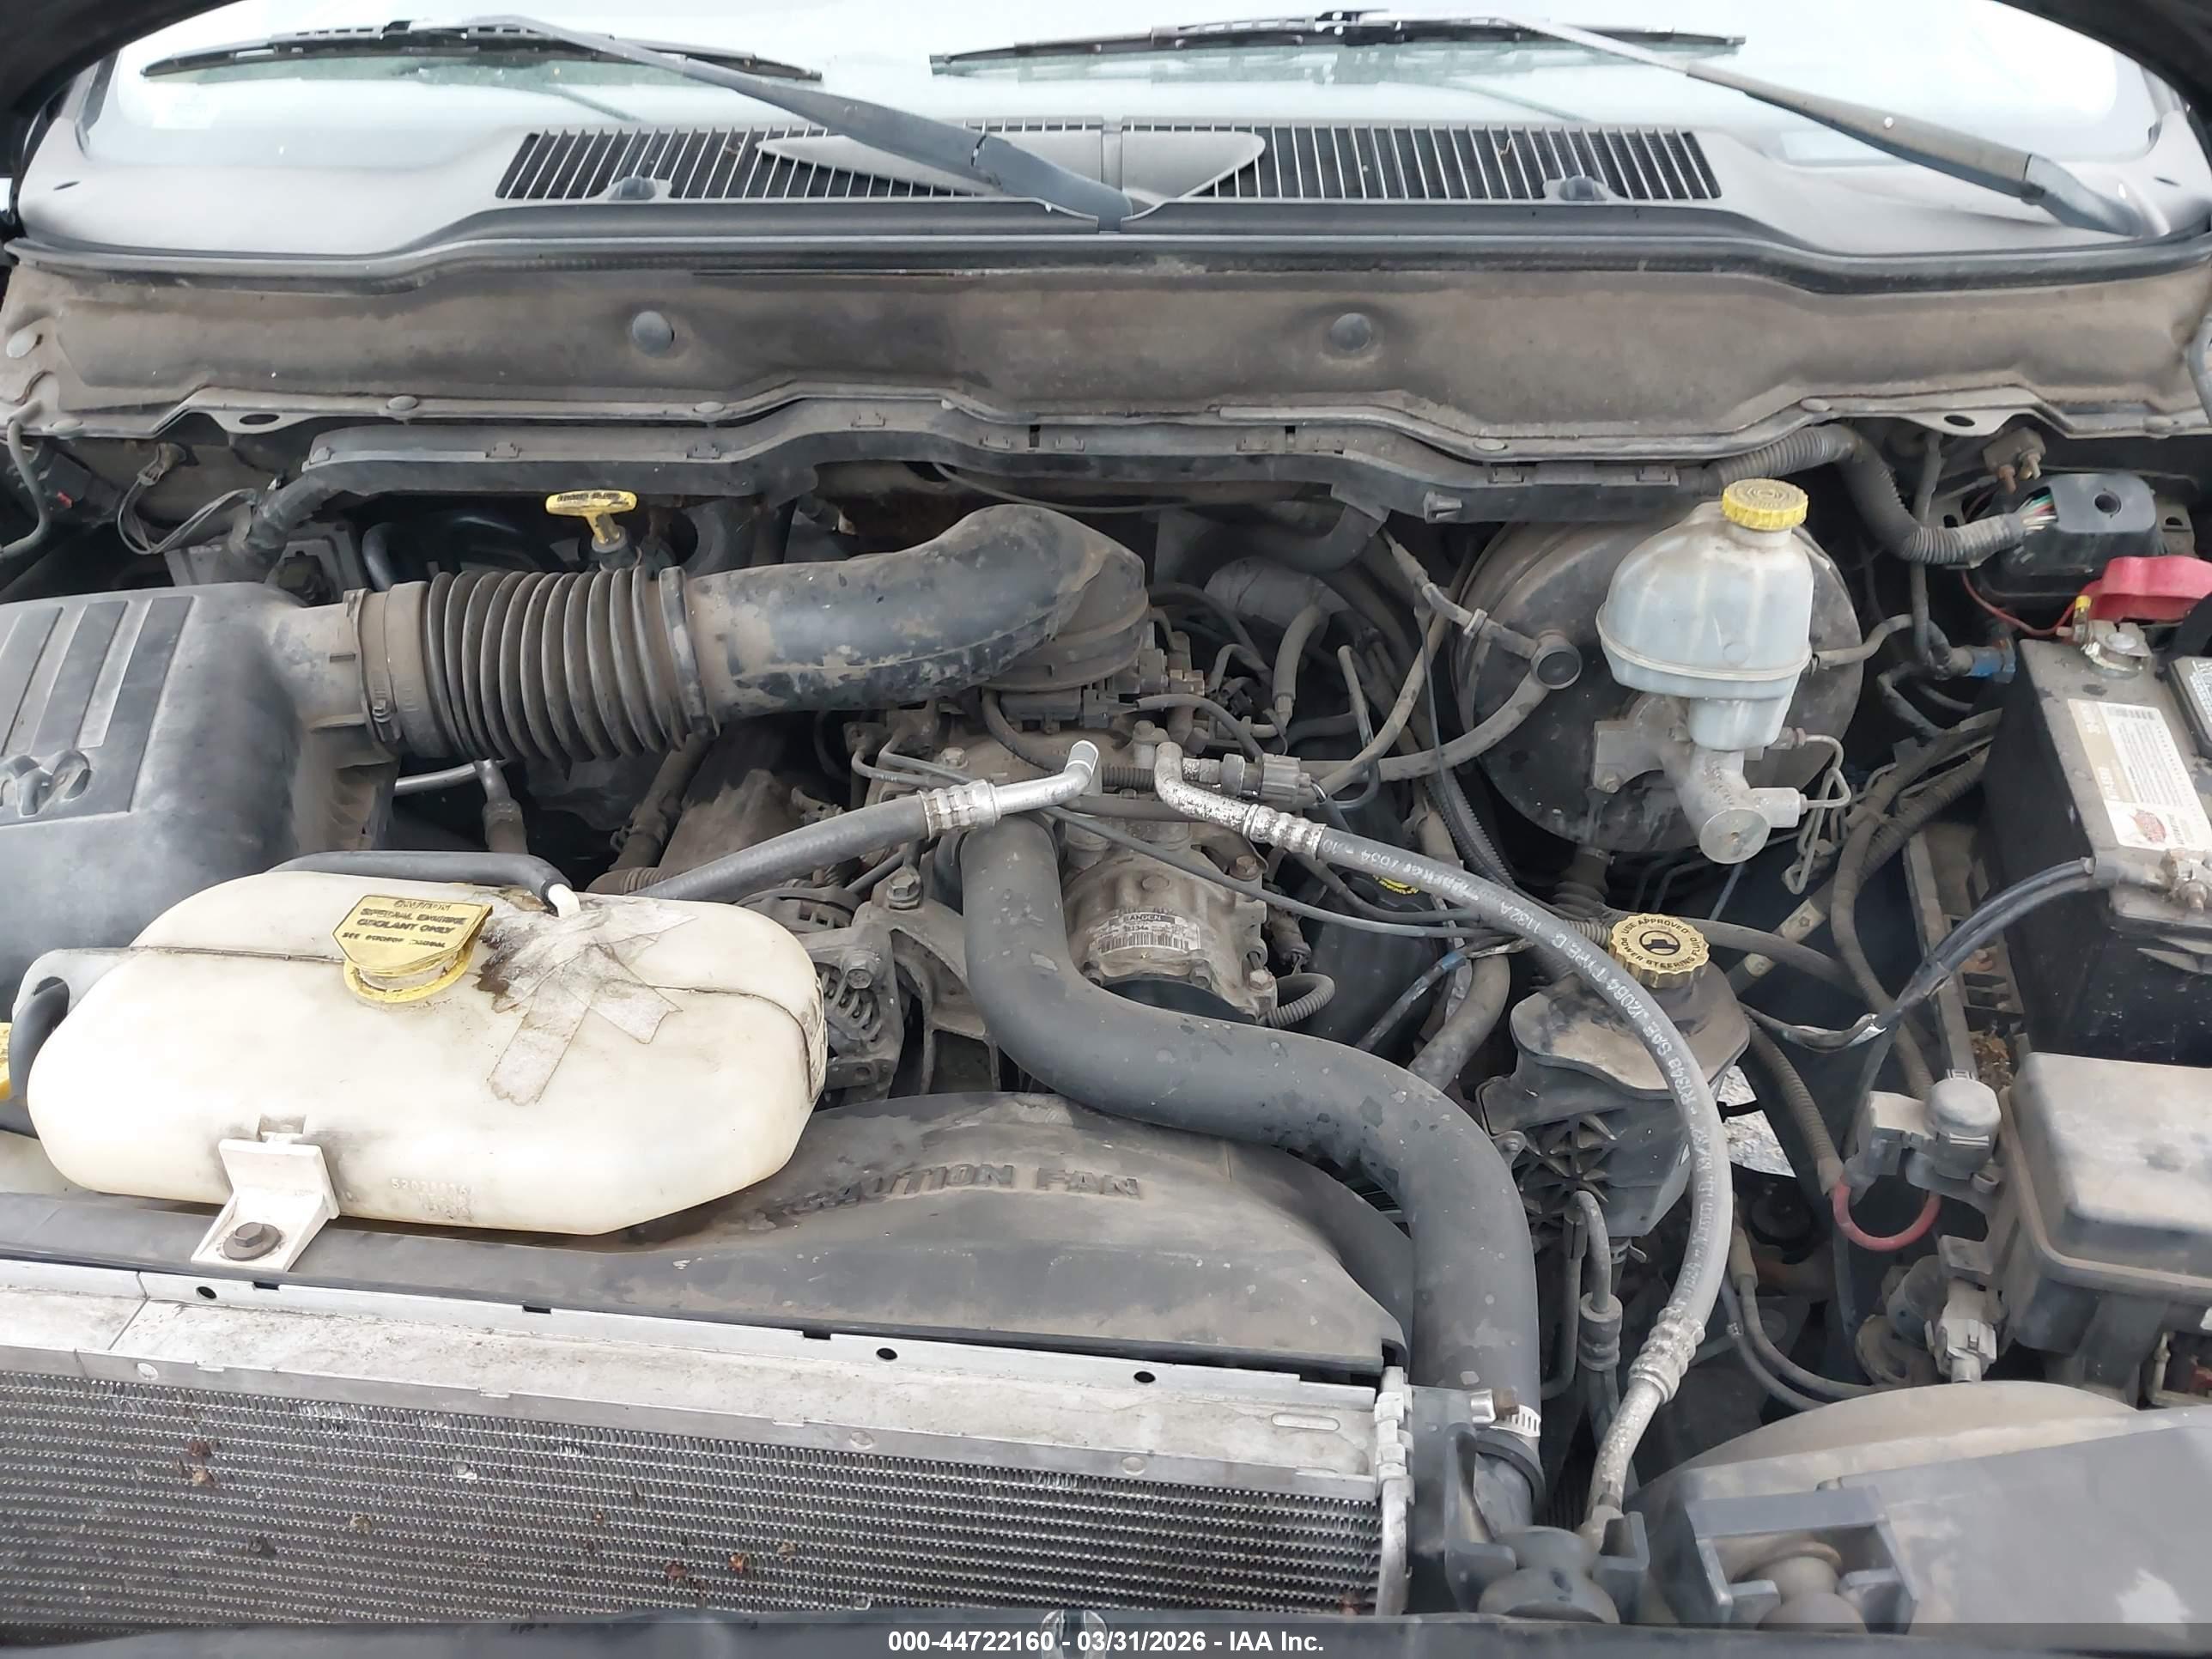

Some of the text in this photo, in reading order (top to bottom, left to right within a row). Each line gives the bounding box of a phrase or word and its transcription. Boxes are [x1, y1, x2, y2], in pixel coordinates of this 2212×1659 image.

[1321, 837, 1342, 855] 10
[356, 919, 417, 932] COOLANT
[361, 908, 413, 921] SPECIAL
[1498, 900, 1540, 934] 1132A
[1621, 917, 1690, 935] USE APPROVED
[1551, 933, 1568, 950] C
[1620, 937, 1701, 969] POWER STEERING FLUID
[1566, 943, 1607, 984] TYPE
[1605, 977, 1650, 1019] J2064
[1643, 1021, 1673, 1056] SAE
[1668, 1056, 1698, 1106] R134a
[1035, 1166, 1141, 1200] FAN
